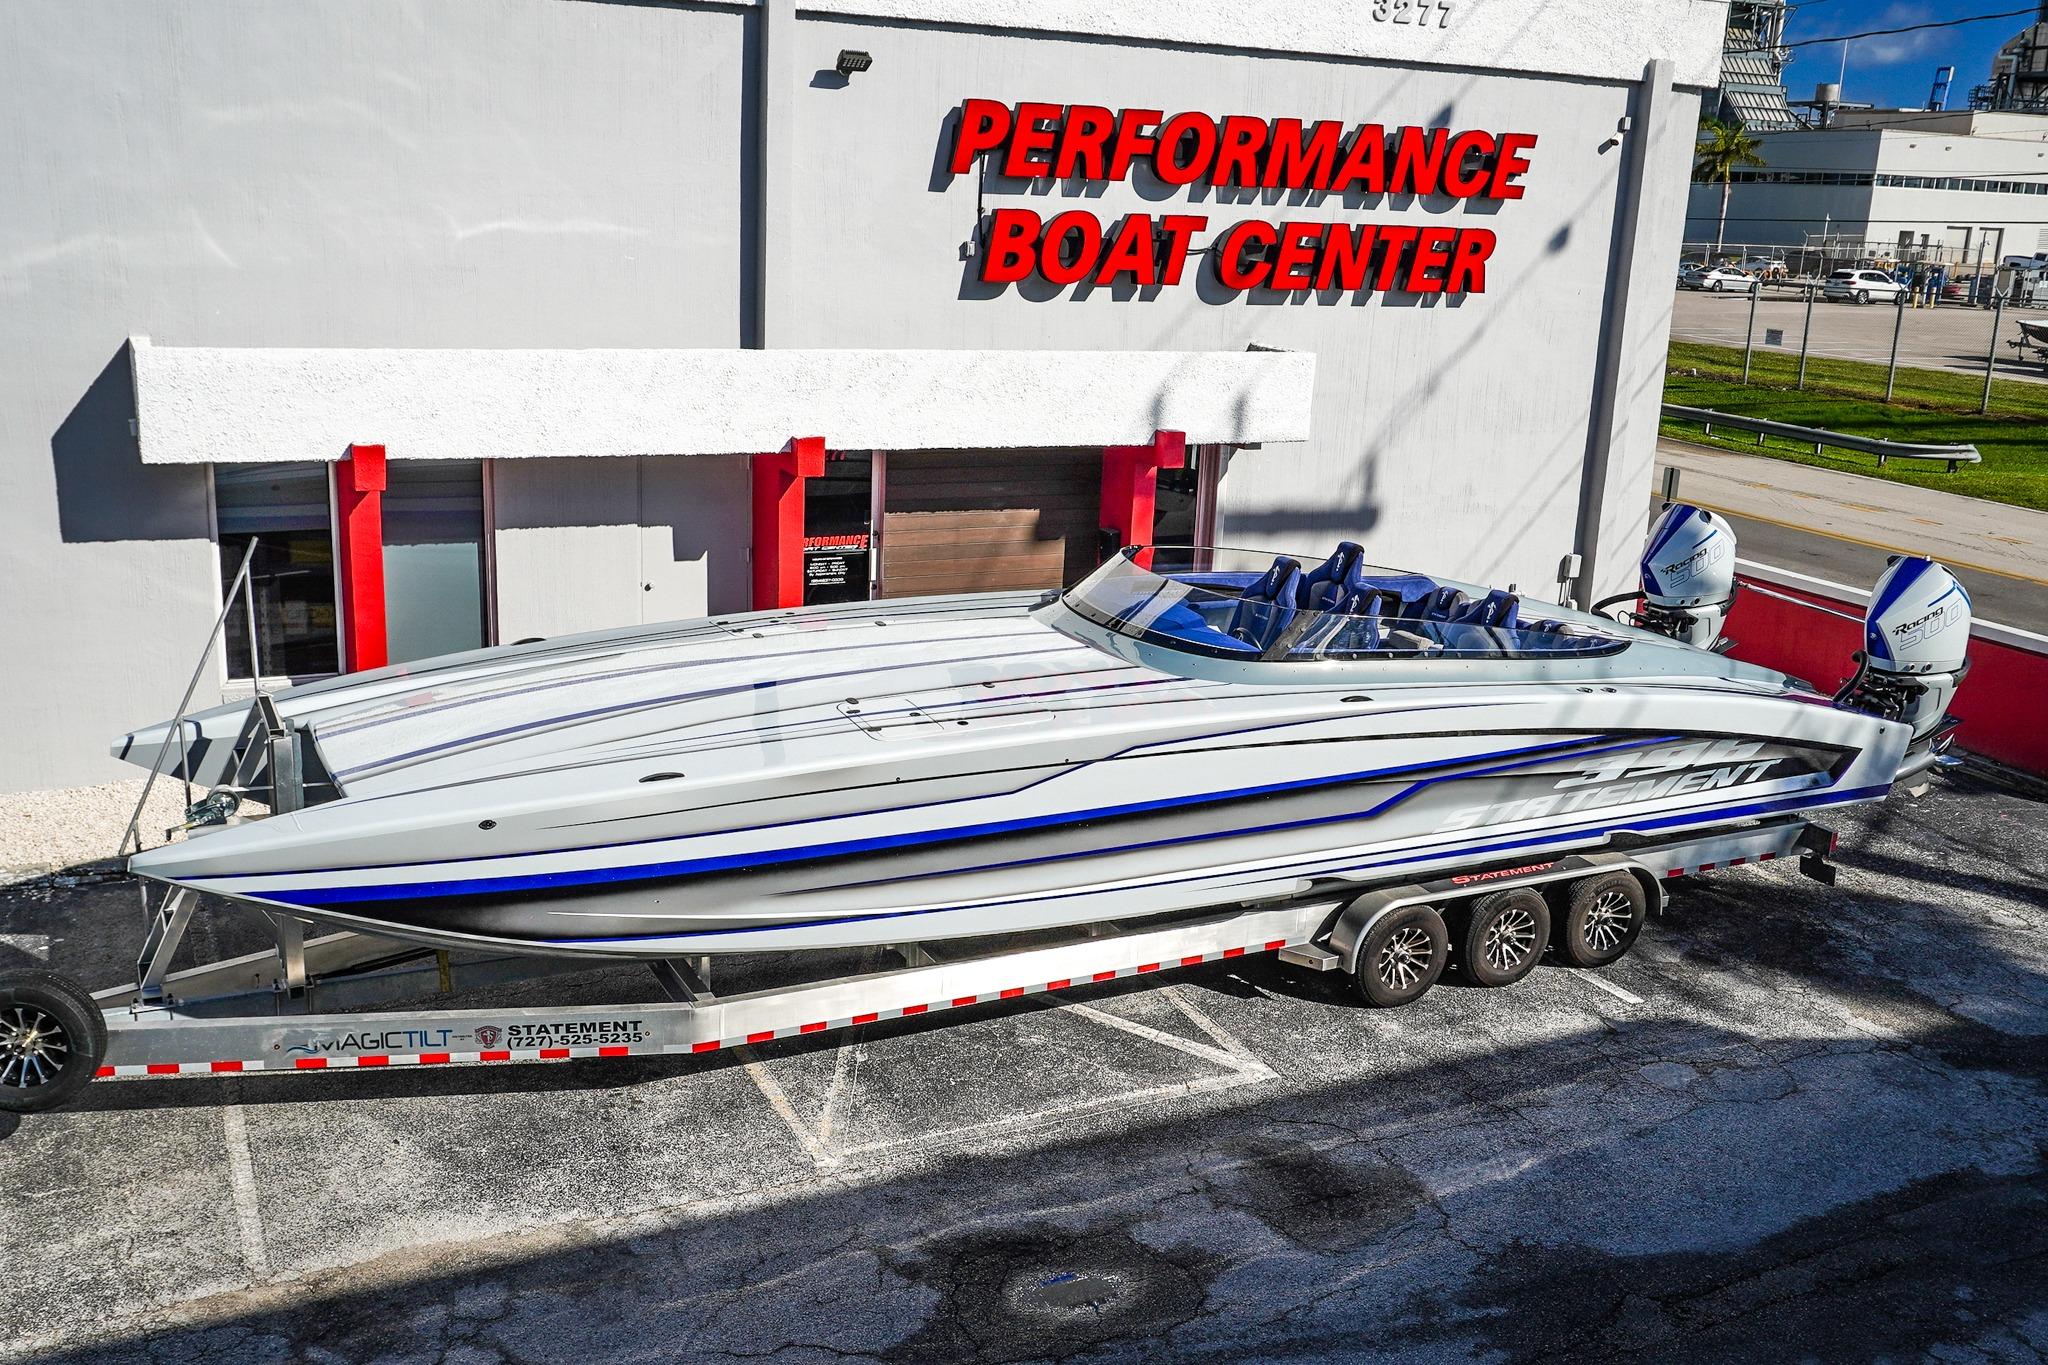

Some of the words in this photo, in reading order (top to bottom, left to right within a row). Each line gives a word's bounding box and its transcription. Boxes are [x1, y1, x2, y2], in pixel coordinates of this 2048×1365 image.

[1372, 0, 1457, 29] 3277
[950, 98, 1538, 200] PERFORMANCE
[981, 208, 1207, 286] BOAT
[1217, 219, 1497, 294] CENTER
[803, 535, 869, 549] RFORMANCE
[1660, 548, 1707, 575] Racing
[1670, 541, 1725, 589] 500
[1892, 606, 1944, 636] Racing
[1899, 598, 1963, 651] 500
[1434, 758, 1784, 834] STATEMENT
[507, 1020, 643, 1036] STATEMENT
[507, 1032, 643, 1049] (727)-525-5235
